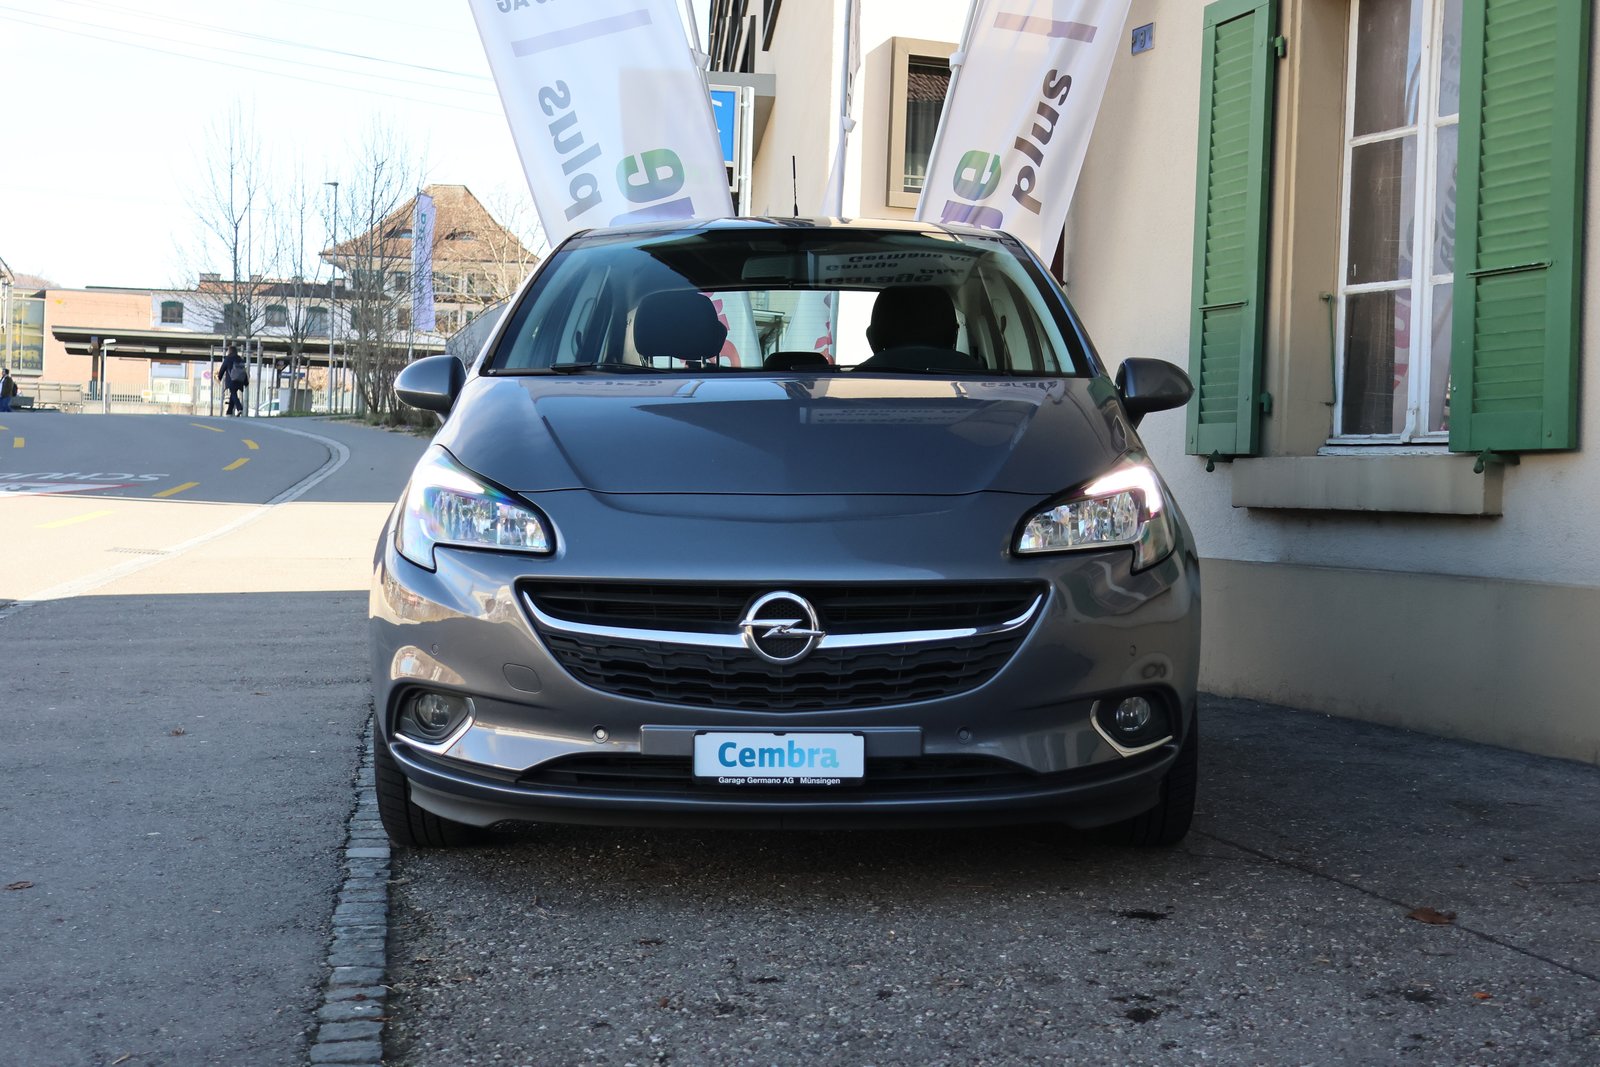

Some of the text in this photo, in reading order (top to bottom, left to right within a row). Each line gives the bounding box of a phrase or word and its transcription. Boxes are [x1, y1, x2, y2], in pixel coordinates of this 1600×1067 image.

[1012, 69, 1072, 215] plus
[718, 740, 840, 768] Cembra
[718, 776, 746, 785] Garage
[747, 776, 781, 784] Germano
[800, 776, 841, 785] Münsingen
